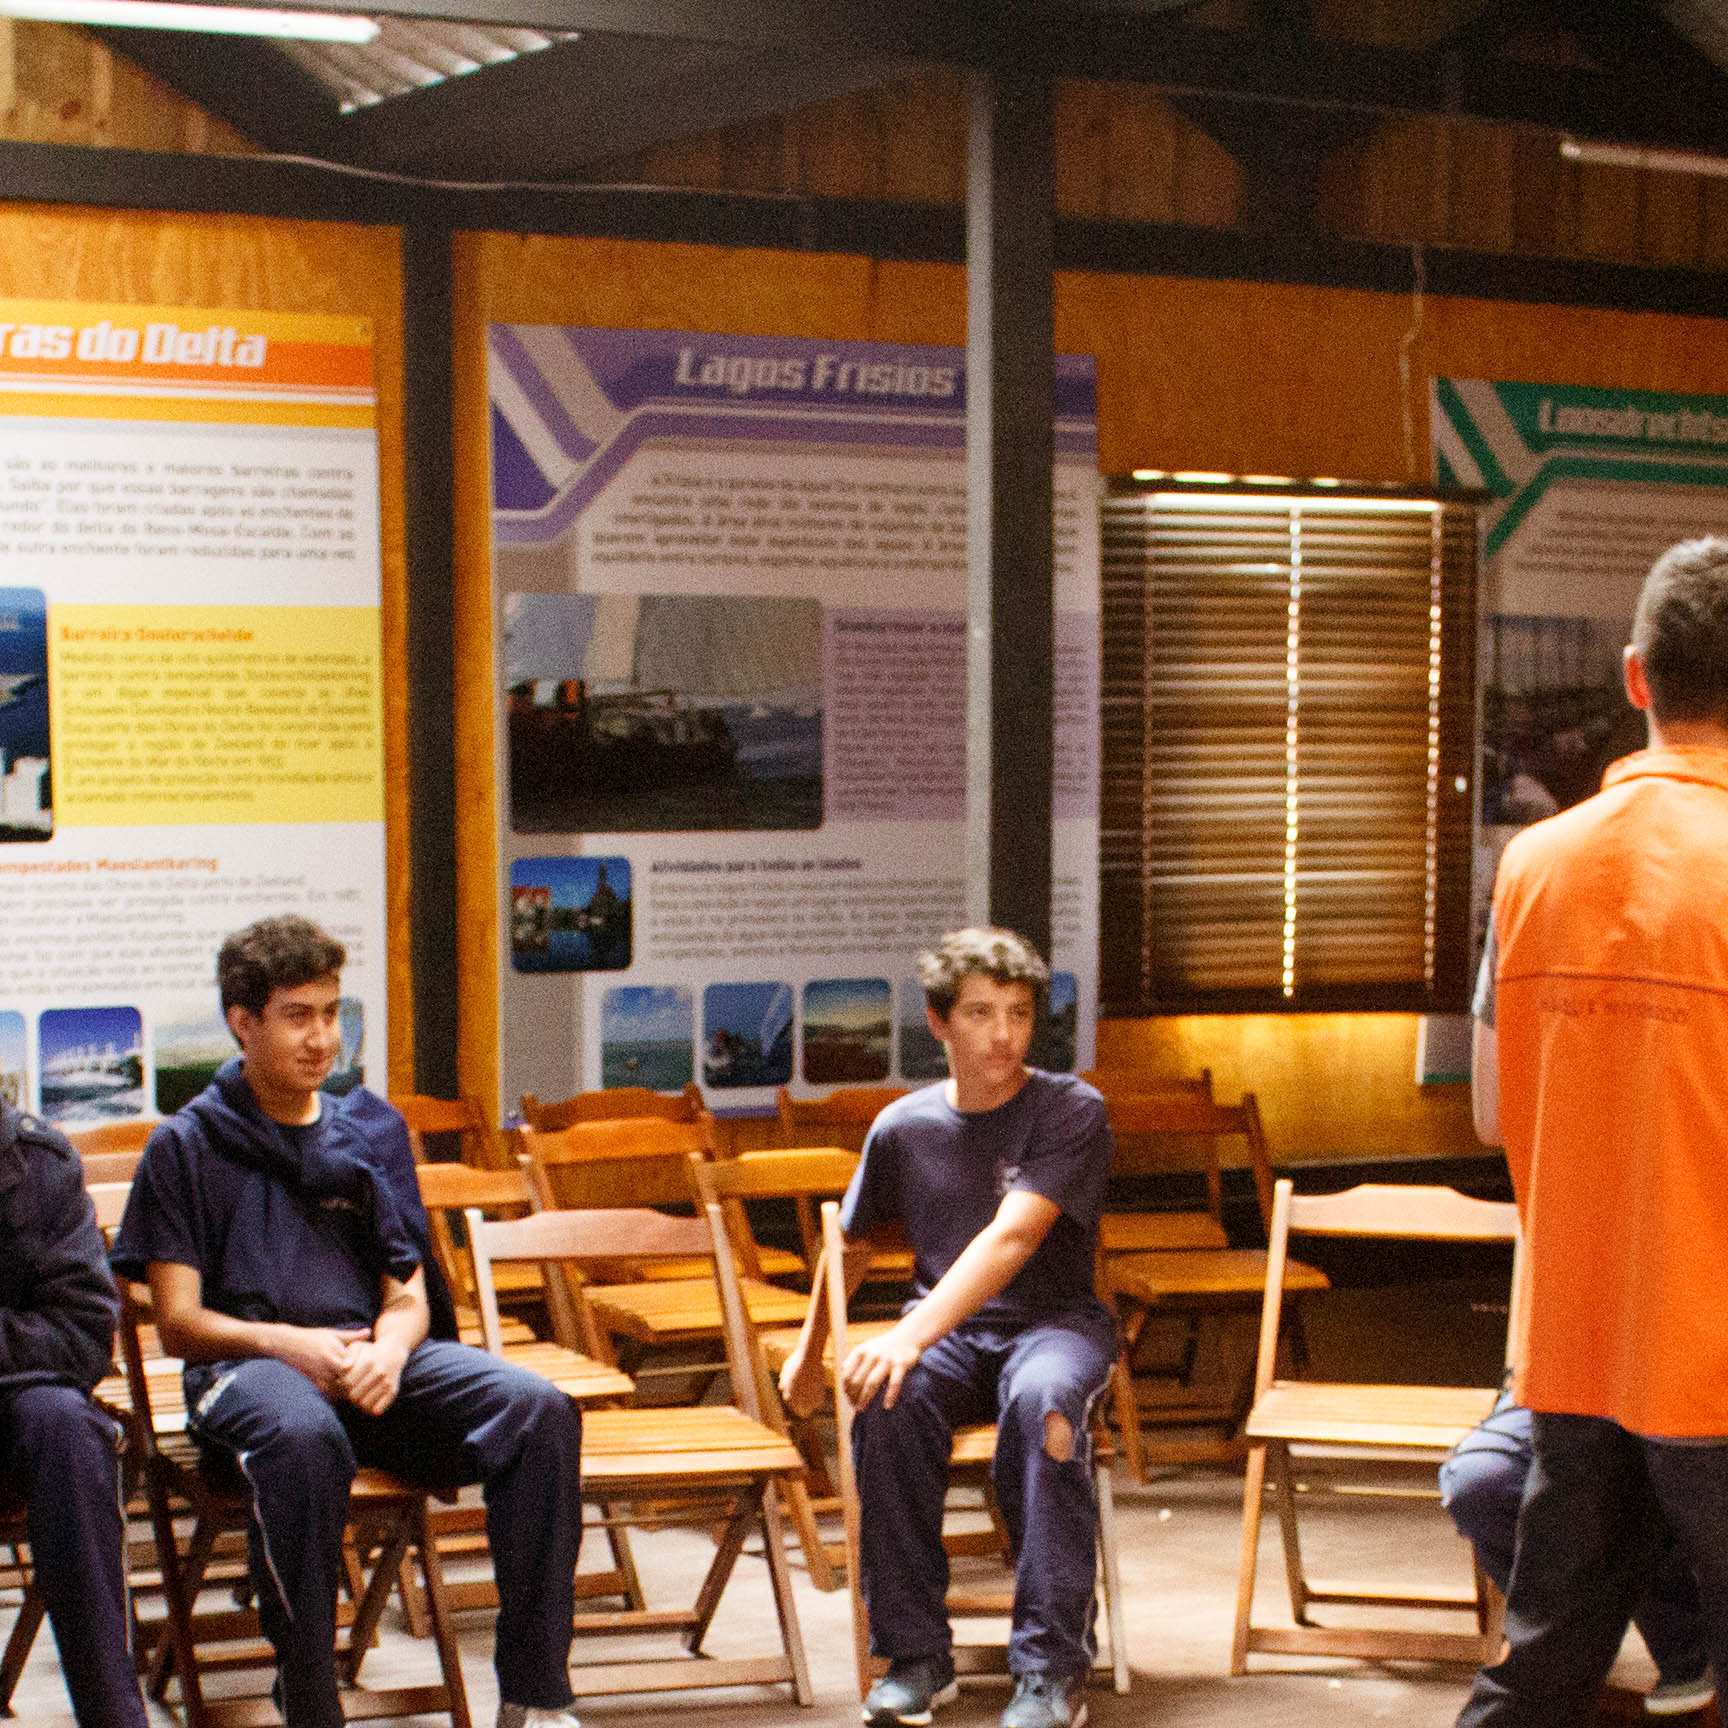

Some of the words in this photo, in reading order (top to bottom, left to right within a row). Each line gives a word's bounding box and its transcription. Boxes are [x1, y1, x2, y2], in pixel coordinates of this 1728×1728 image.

[76, 320, 133, 361] do
[142, 322, 267, 367] Delta
[675, 348, 807, 397] Lagos
